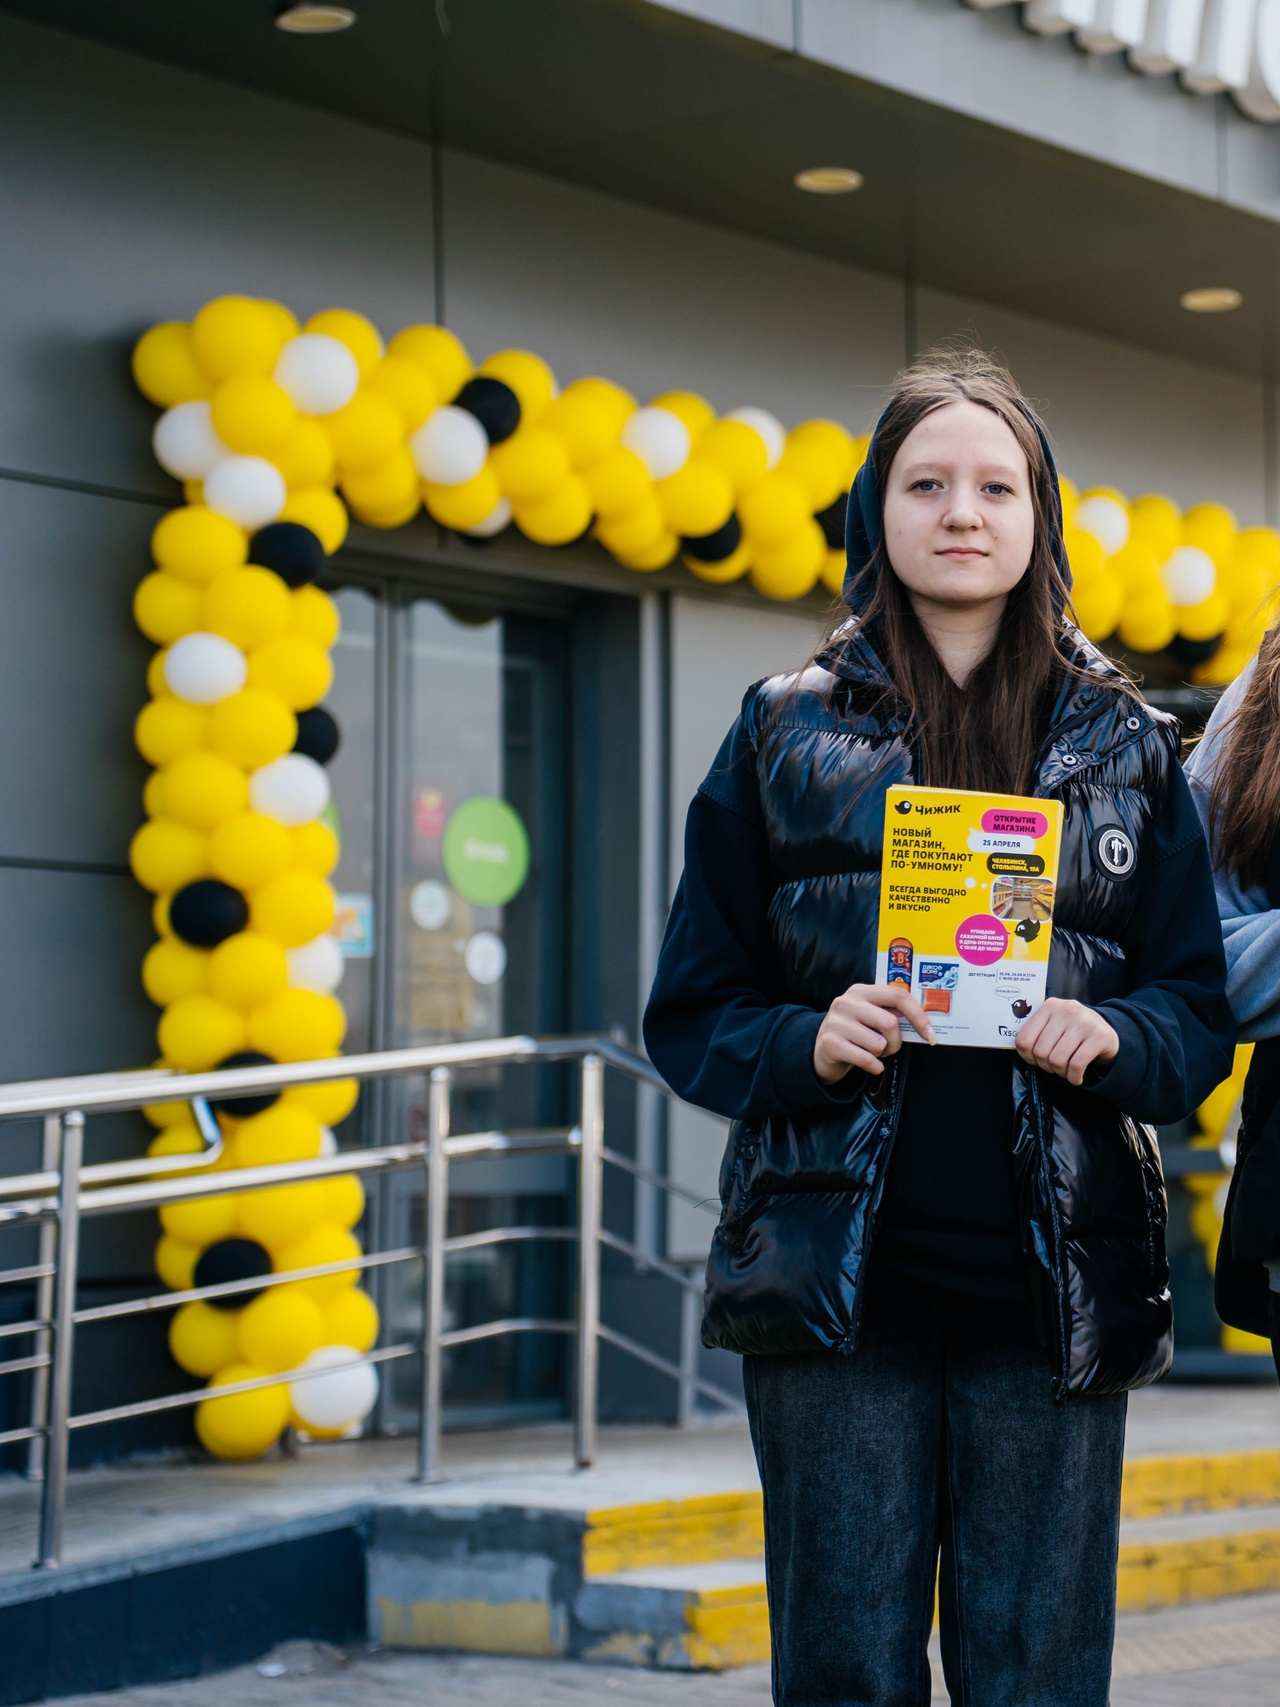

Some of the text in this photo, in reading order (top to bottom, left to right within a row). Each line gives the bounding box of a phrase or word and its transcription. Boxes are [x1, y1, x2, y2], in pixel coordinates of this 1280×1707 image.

[915, 804, 961, 815] Чижик
[994, 815, 1036, 824] ОТКРЫТИЕ
[893, 827, 931, 837] НОВЫЙ
[993, 824, 1035, 832] МАГАЗИНА
[892, 839, 945, 851] МАГАЗИН,
[892, 850, 973, 861] ГДЕ ПОКУПАЮТ
[891, 860, 962, 872] ПО-УМНОМУ!
[890, 885, 966, 896] ВСЕГДА ВЫГОДНО
[889, 894, 950, 904] КАЧЕСТВЕННО
[897, 904, 930, 912] ВКУСНО
